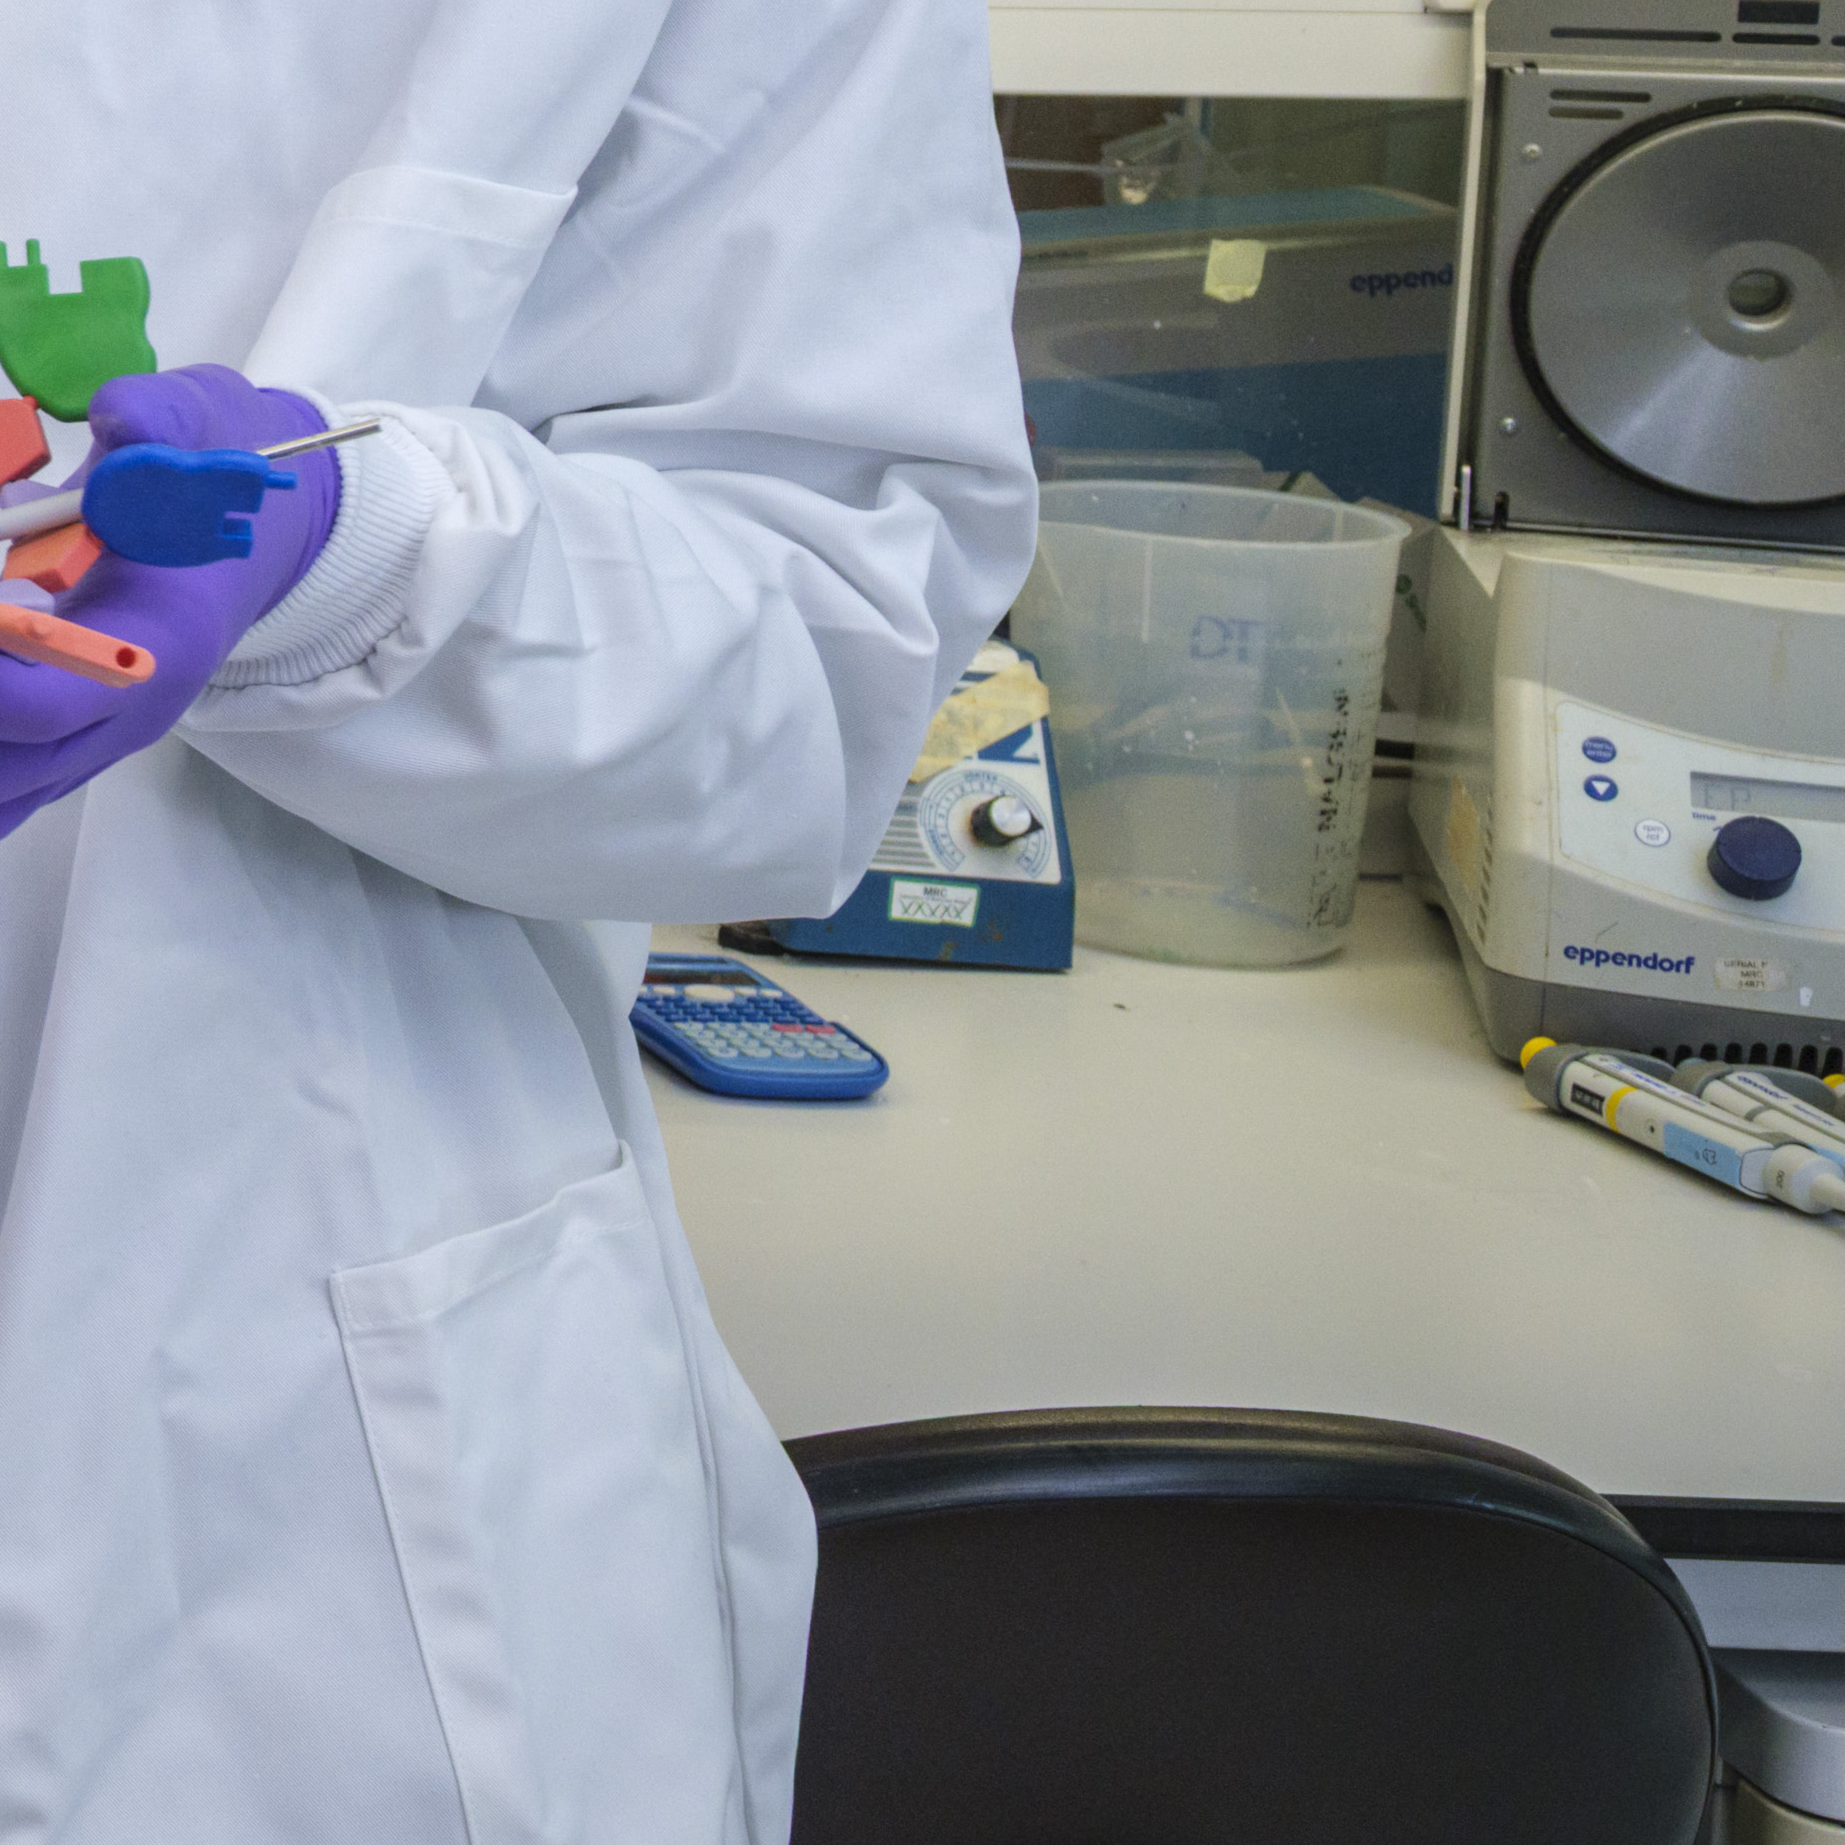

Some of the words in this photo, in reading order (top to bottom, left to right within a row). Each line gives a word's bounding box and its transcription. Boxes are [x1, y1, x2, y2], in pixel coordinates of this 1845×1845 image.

[1349, 264, 1454, 299] eppend
[1692, 811, 1717, 822] time
[924, 886, 948, 898] MRC
[1564, 944, 1695, 975] eppendorf
